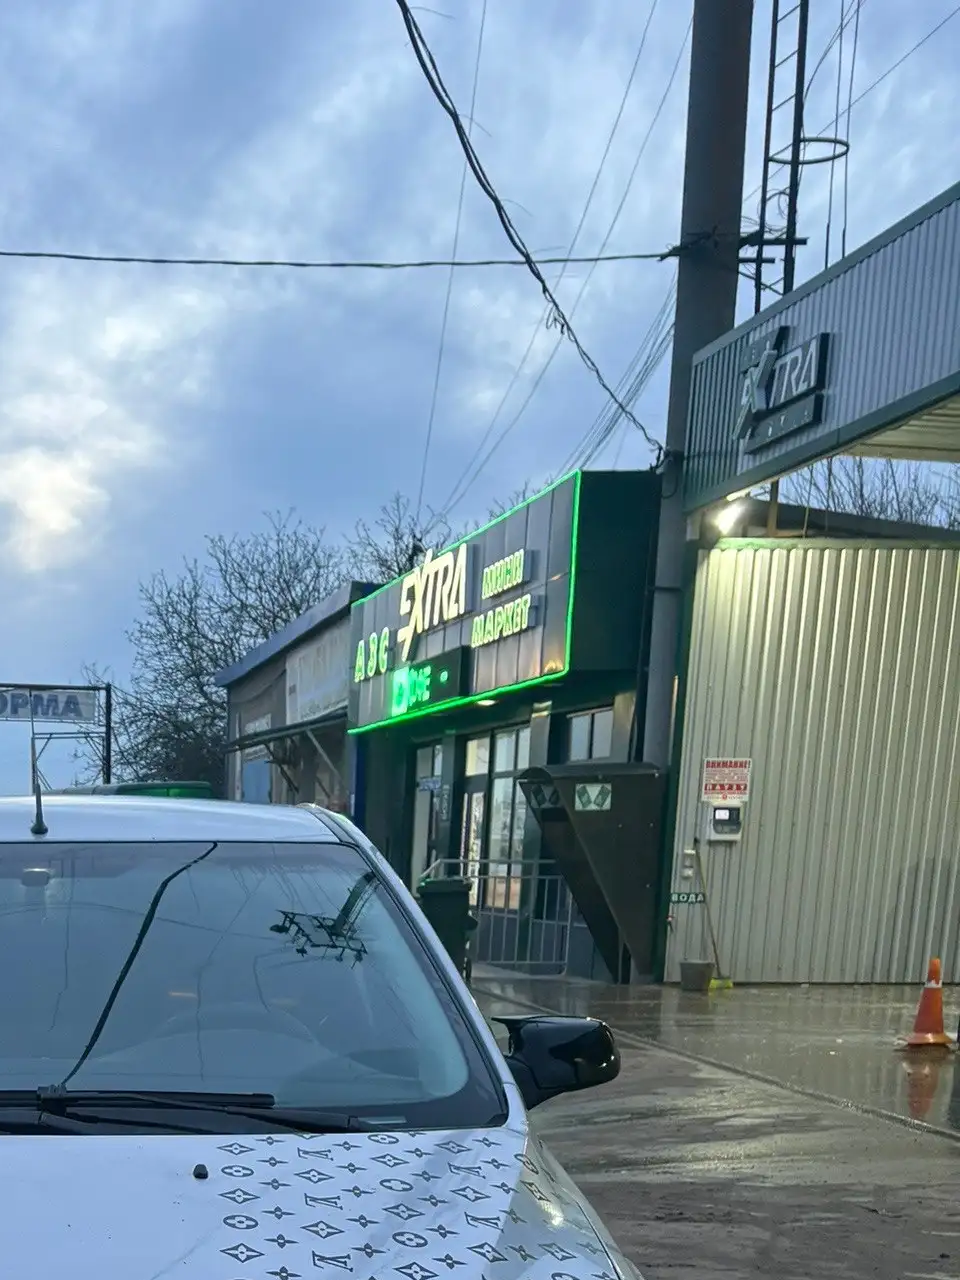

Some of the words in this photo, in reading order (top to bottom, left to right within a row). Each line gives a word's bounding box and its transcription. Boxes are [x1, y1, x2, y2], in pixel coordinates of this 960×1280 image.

[397, 542, 467, 662] EXTRA
[471, 593, 531, 648] МАРКЕТ
[671, 892, 704, 902] ВОДА
